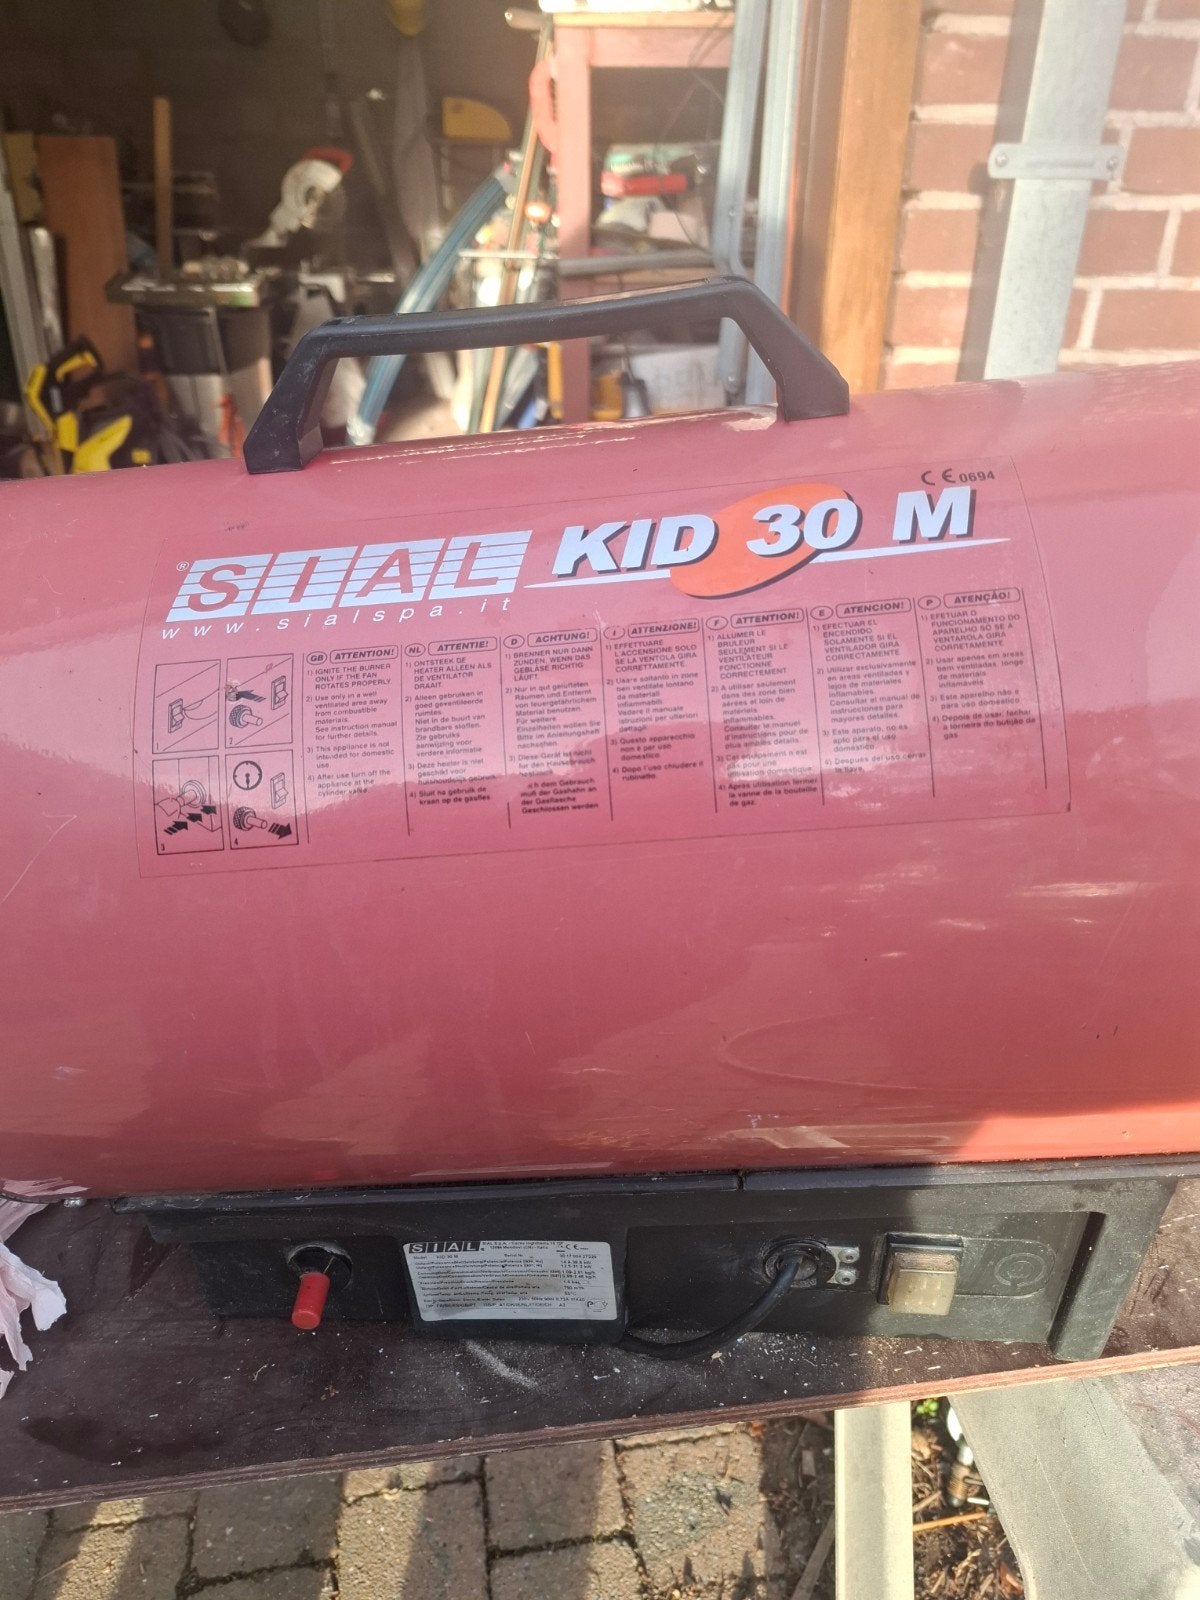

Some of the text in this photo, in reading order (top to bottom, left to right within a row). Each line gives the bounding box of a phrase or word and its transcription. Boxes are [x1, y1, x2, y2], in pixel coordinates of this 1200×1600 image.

[959, 471, 995, 483] 0694
[552, 486, 977, 577] KID 30 M
[171, 533, 525, 620] SIAL
[736, 612, 799, 624] ATTENTION!
[632, 622, 697, 634] ATTENZIONE!
[536, 632, 590, 643] ACHTUNG!
[437, 641, 488, 651] ATTENTIE!
[675, 644, 697, 652] SOLO
[335, 649, 394, 660] ATTENTION!
[514, 650, 550, 658] BRENNER
[427, 672, 473, 681] VENTILATOR
[315, 682, 349, 690] ROTATES
[412, 1242, 476, 1252] SIAL
